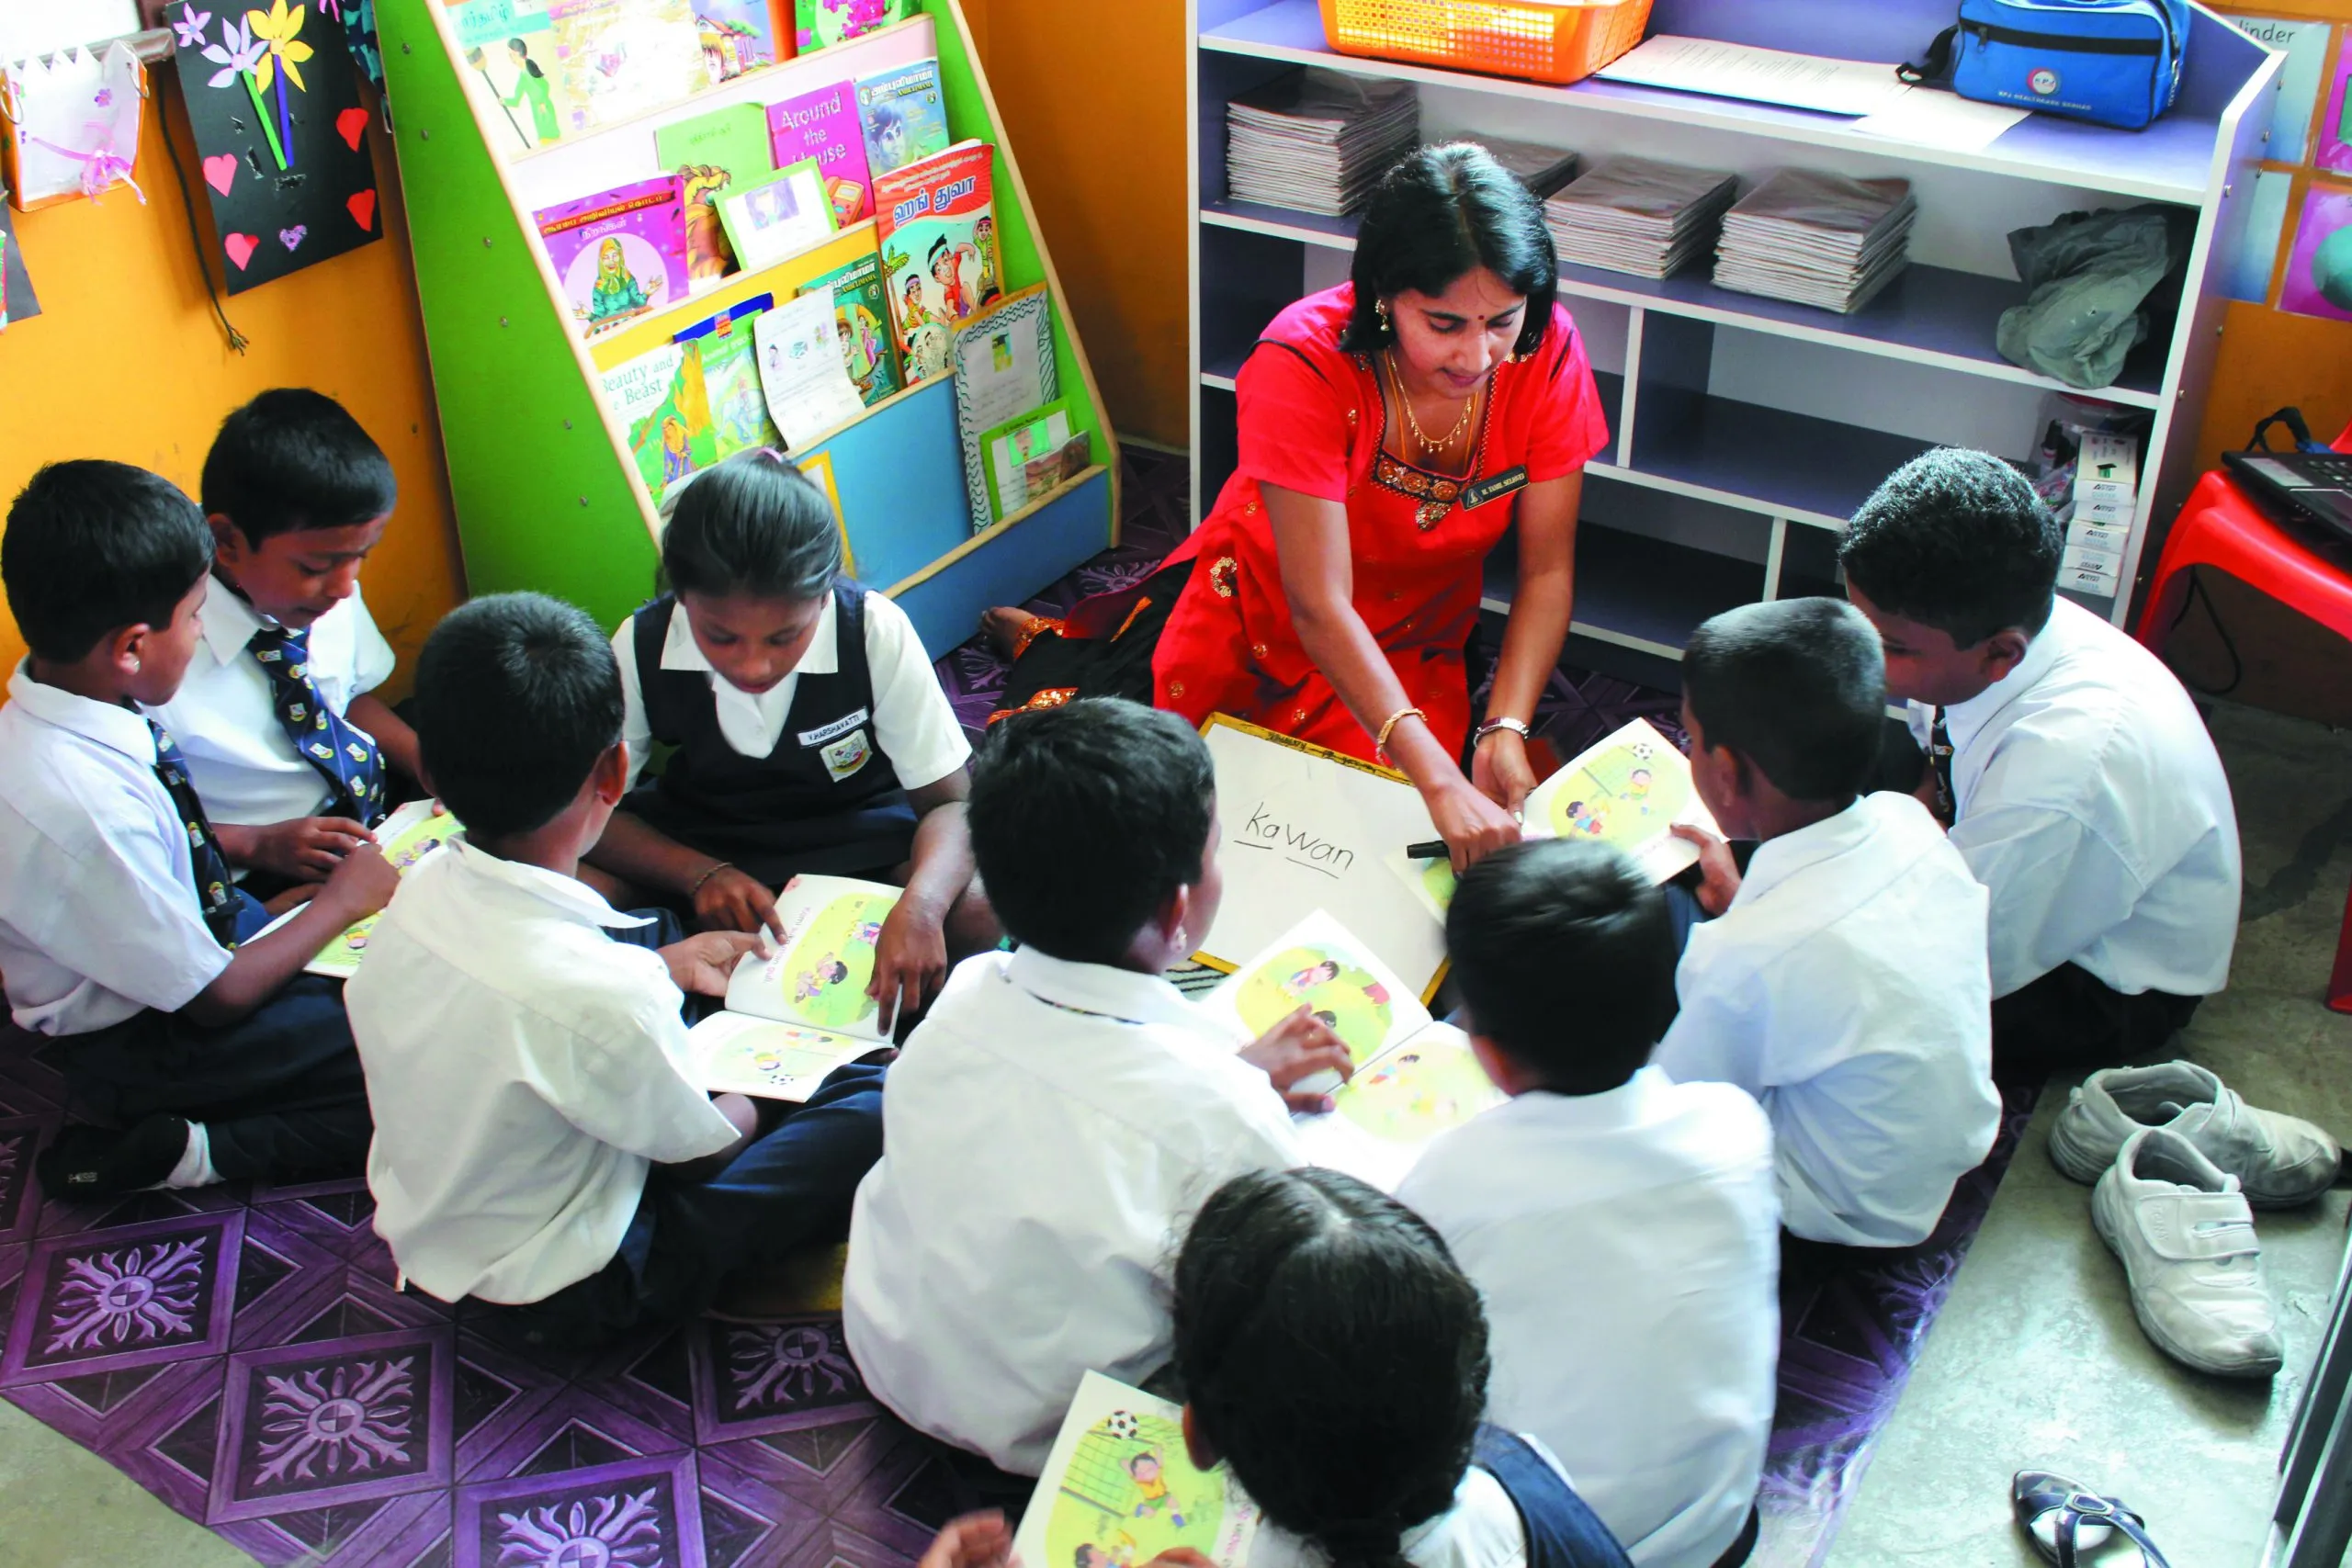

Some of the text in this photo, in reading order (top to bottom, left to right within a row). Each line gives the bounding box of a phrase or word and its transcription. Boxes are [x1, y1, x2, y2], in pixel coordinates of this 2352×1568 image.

[781, 92, 842, 129] Around
[804, 128, 827, 146] the
[933, 175, 975, 210] துவா
[653, 355, 674, 375] and
[625, 380, 663, 406] Beast
